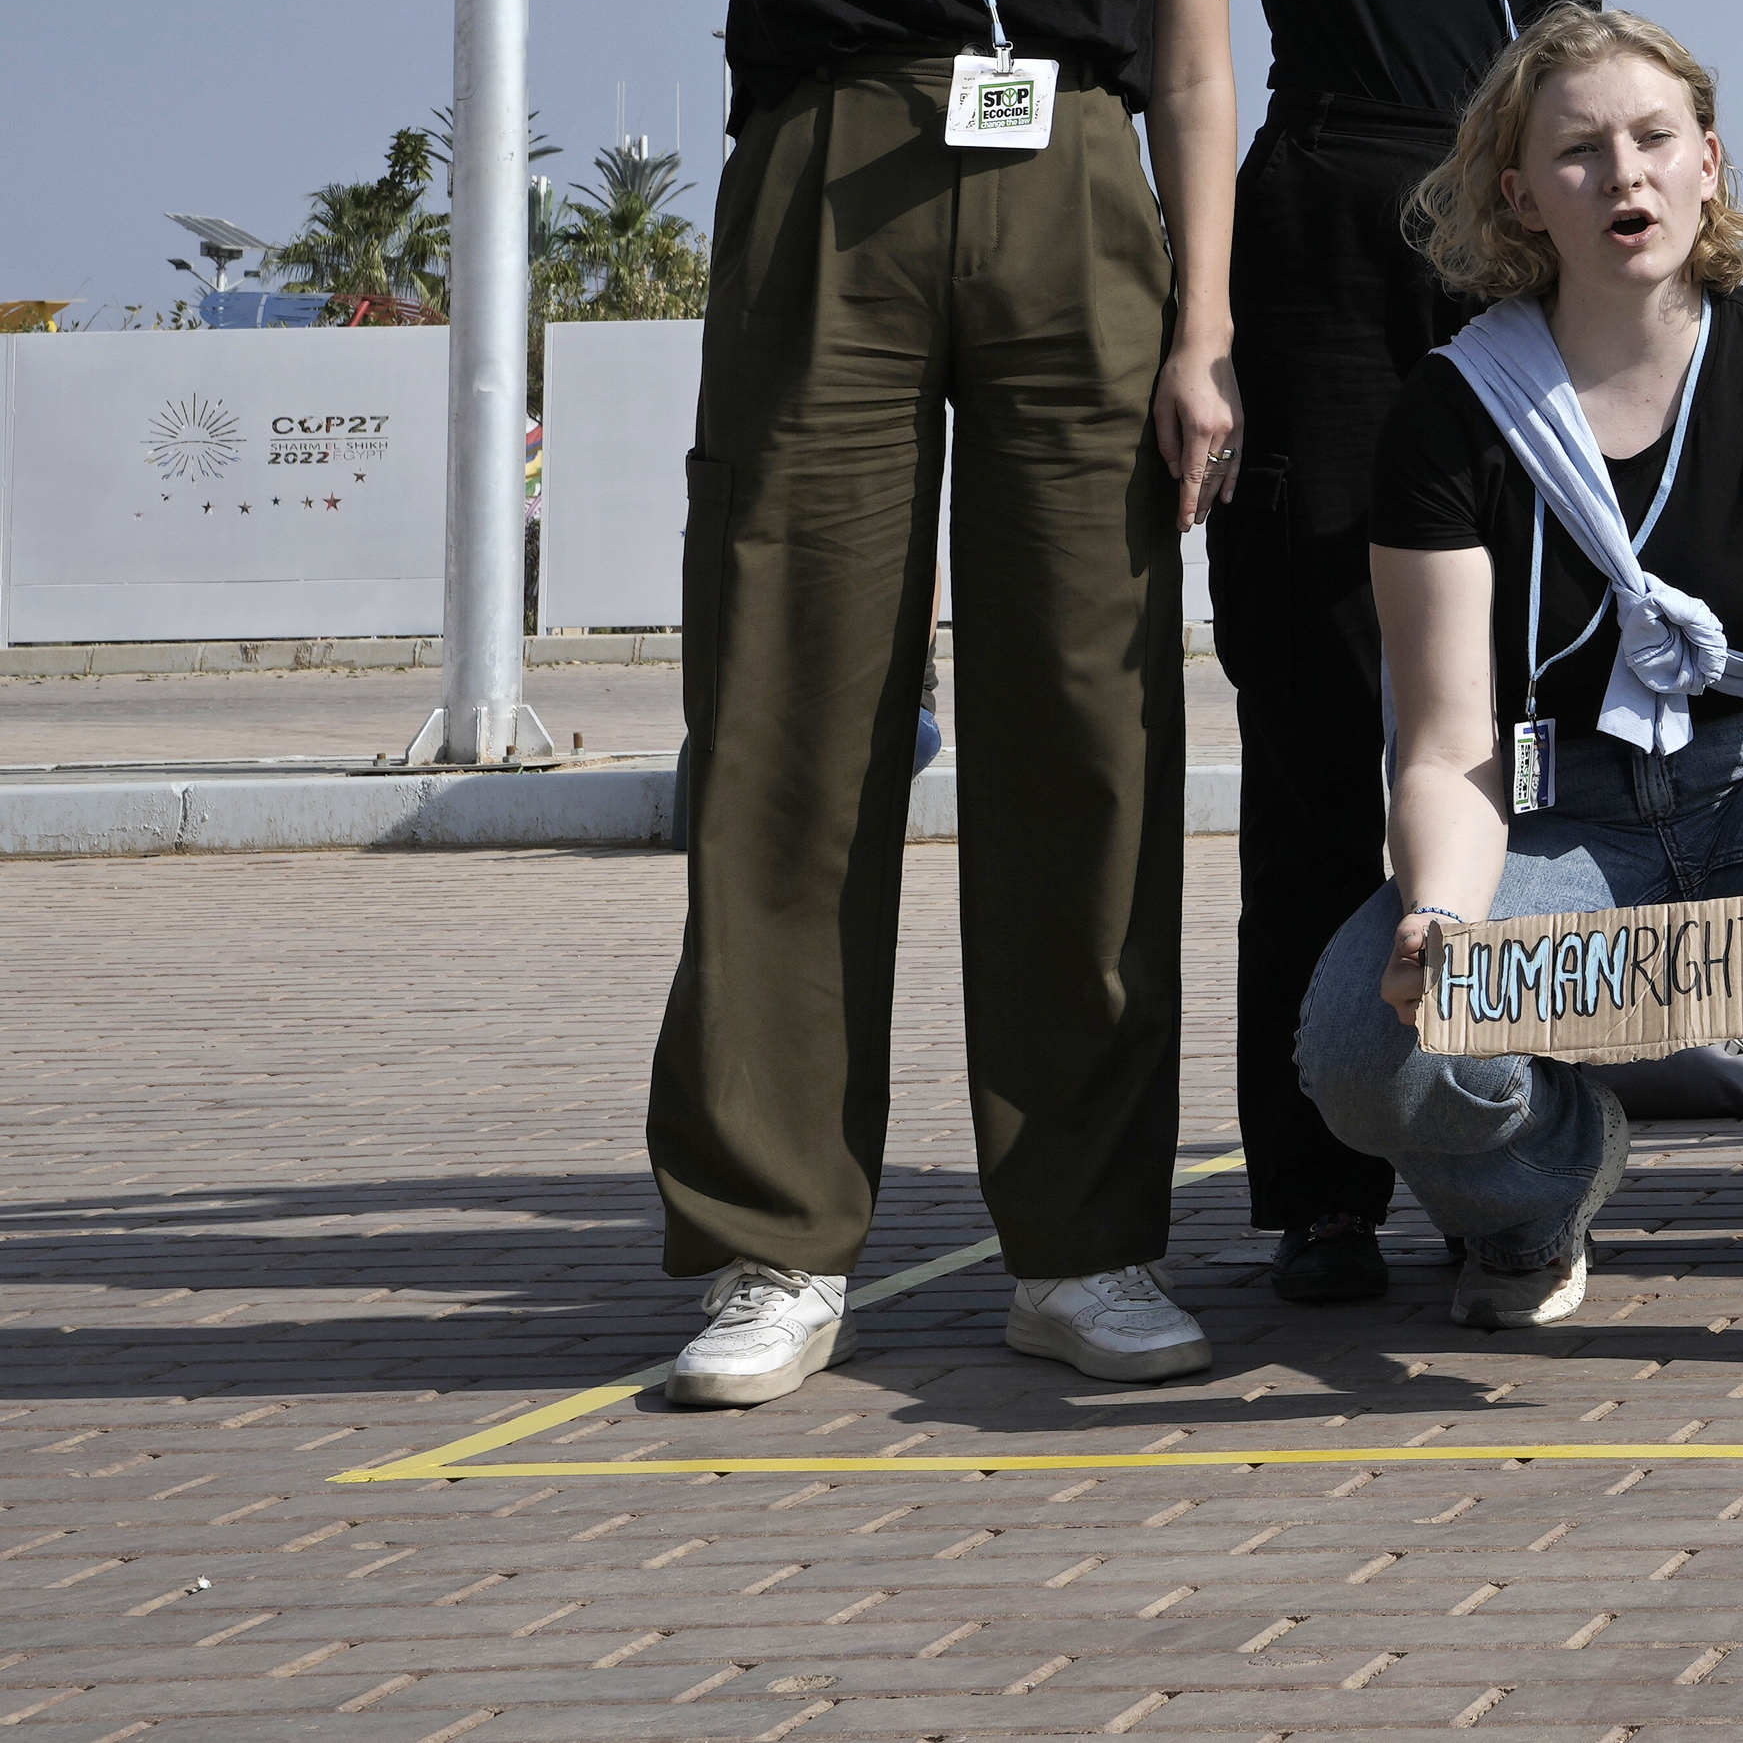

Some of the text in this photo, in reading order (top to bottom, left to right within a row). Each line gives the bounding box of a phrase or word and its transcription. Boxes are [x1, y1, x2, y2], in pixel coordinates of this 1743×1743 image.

[983, 87, 1030, 108] STOP
[983, 106, 1030, 120] ECOCIDE
[272, 416, 389, 434] COP27
[271, 443, 320, 452] SHARM
[325, 442, 340, 451] EL
[268, 450, 386, 465] 2022 EGYPT
